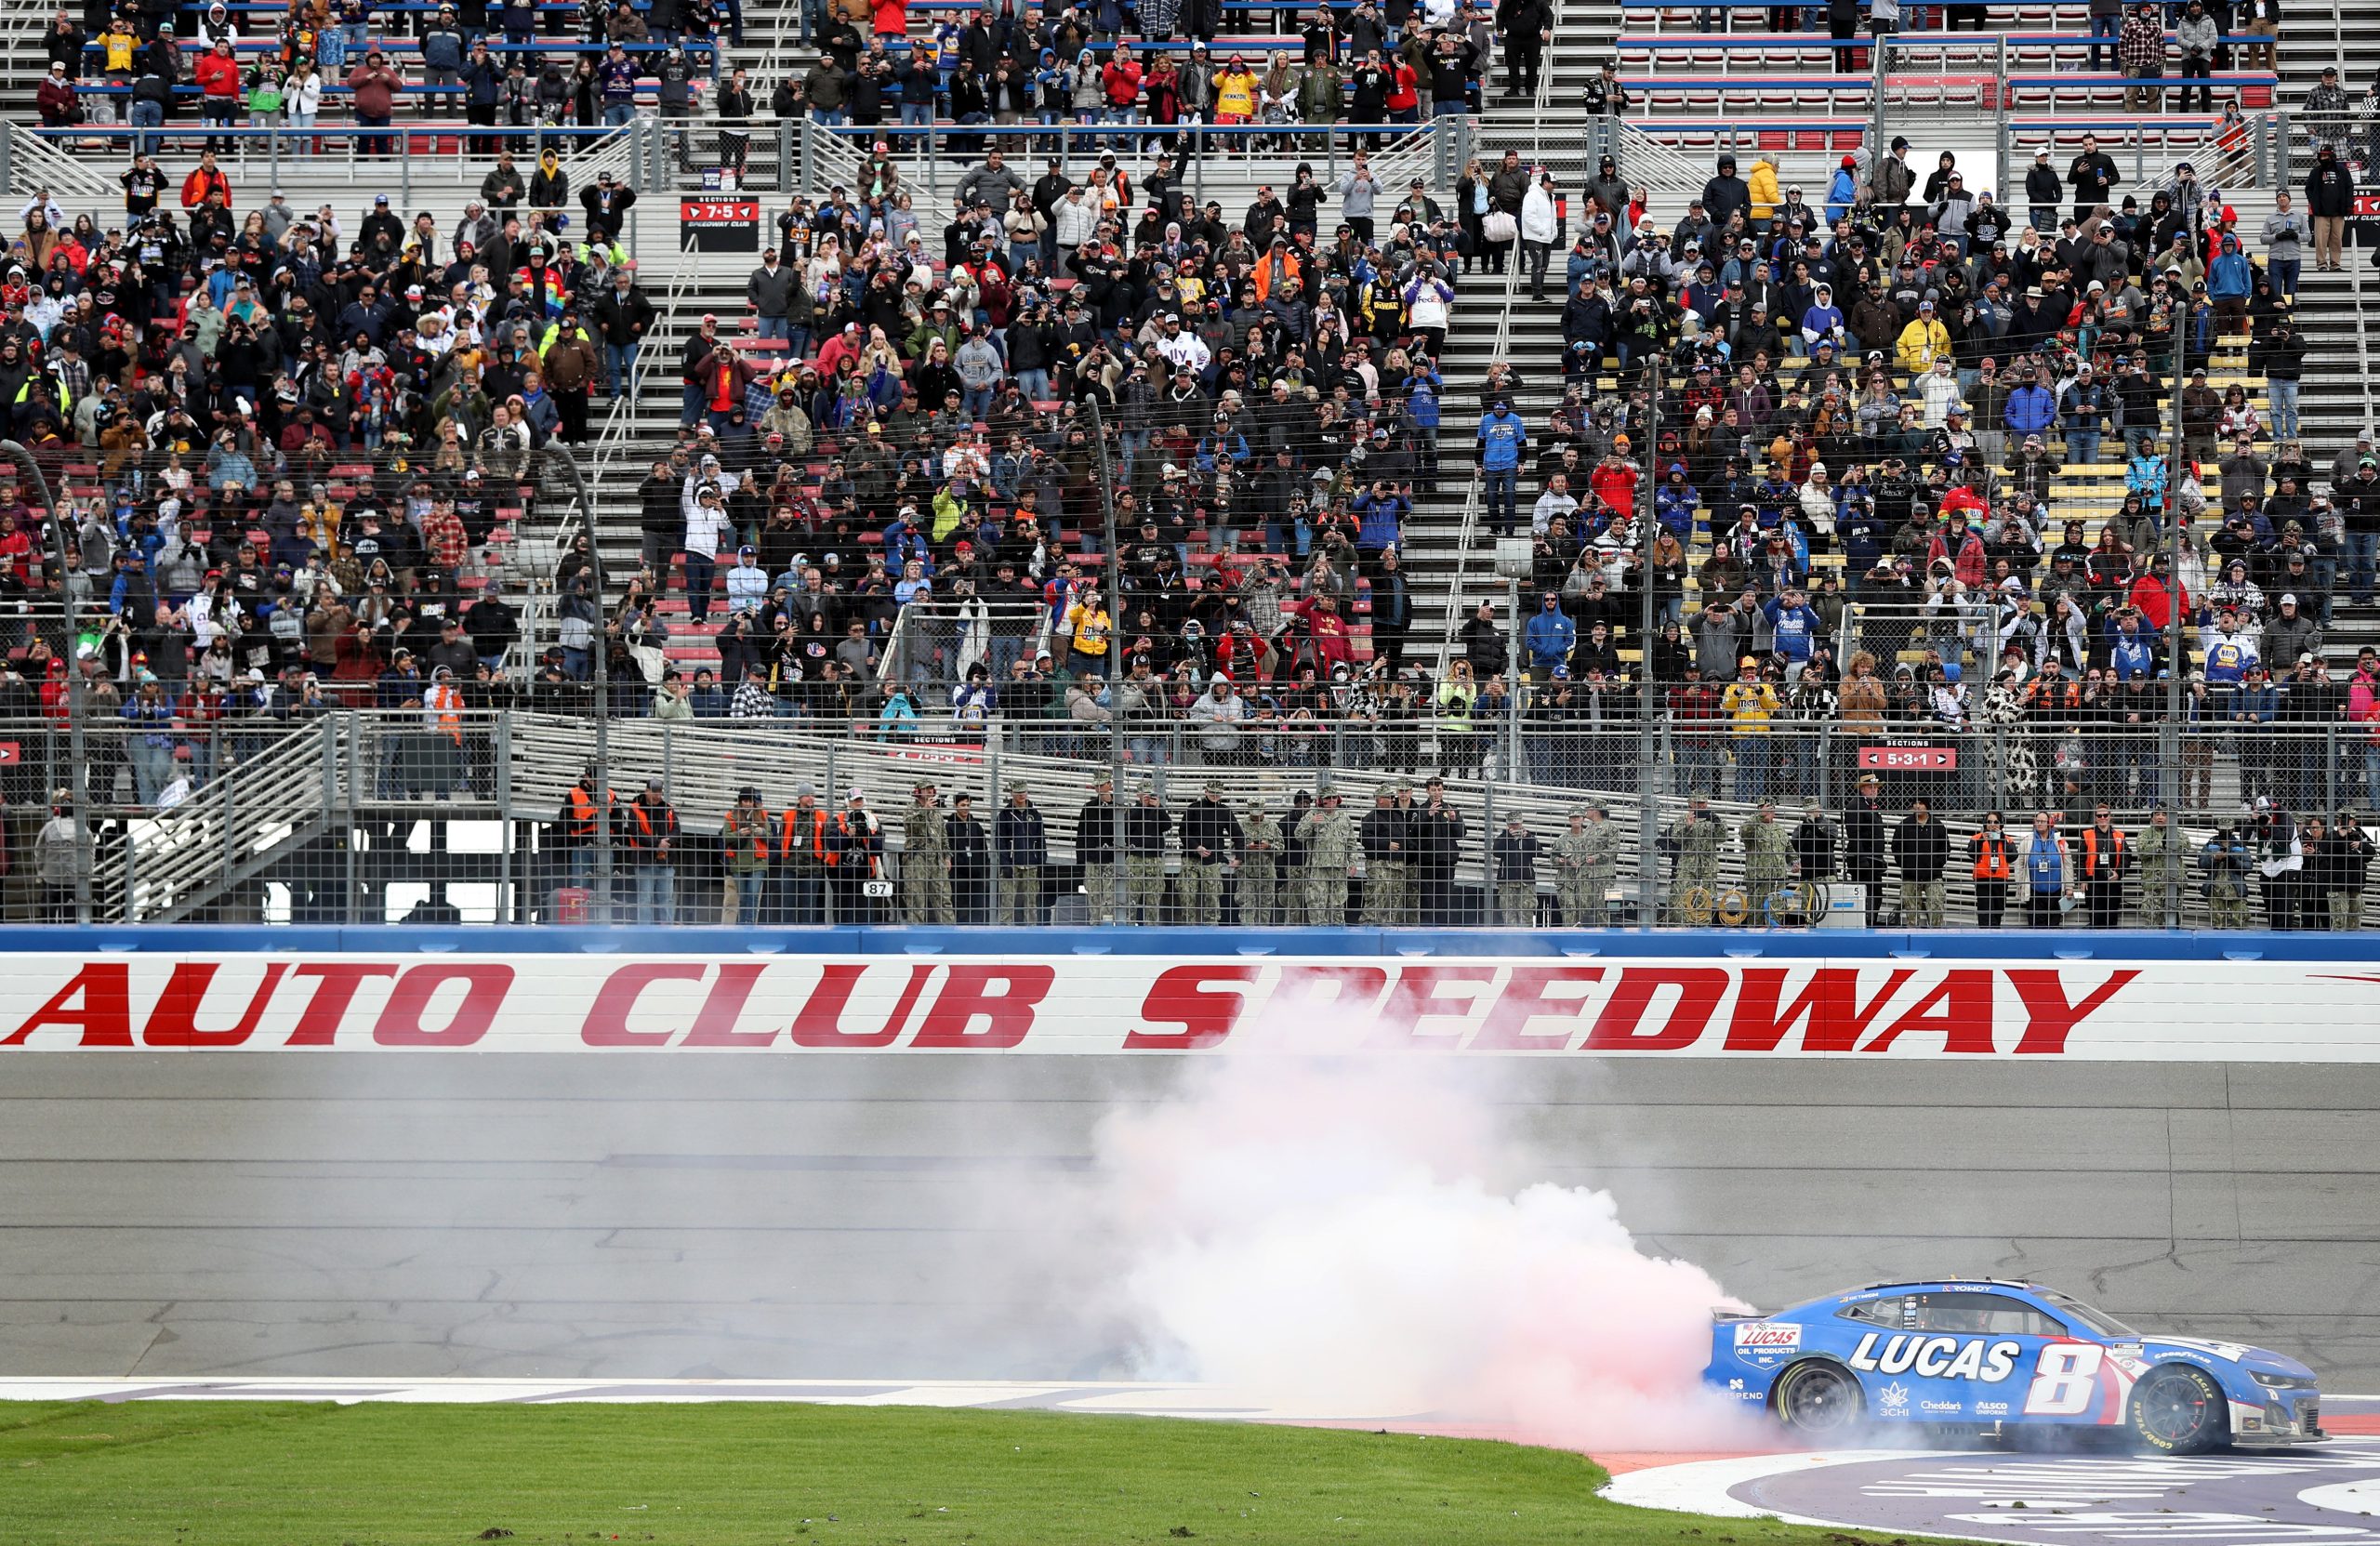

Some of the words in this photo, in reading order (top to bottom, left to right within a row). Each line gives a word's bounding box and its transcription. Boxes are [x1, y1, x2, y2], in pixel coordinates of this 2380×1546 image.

[1418, 295, 1442, 304] FedEx
[2221, 649, 2236, 659] NAPA
[869, 884, 886, 894] 87
[1854, 887, 1859, 895] 5
[0, 962, 515, 1048] AUTO
[583, 963, 1056, 1049] CLUB
[1123, 965, 2143, 1054] SPEEDWAY
[1741, 1331, 1797, 1345] LUCAS
[1847, 1332, 2021, 1383] LUCAS
[2154, 1351, 2212, 1365] GOODYEAR
[2023, 1342, 2106, 1415] 8
[2190, 1373, 2214, 1399] EAGLE
[1880, 1407, 1910, 1417] 3CHI
[1920, 1400, 1962, 1410] Cheddar's
[2134, 1400, 2173, 1449] GOODYEAR
